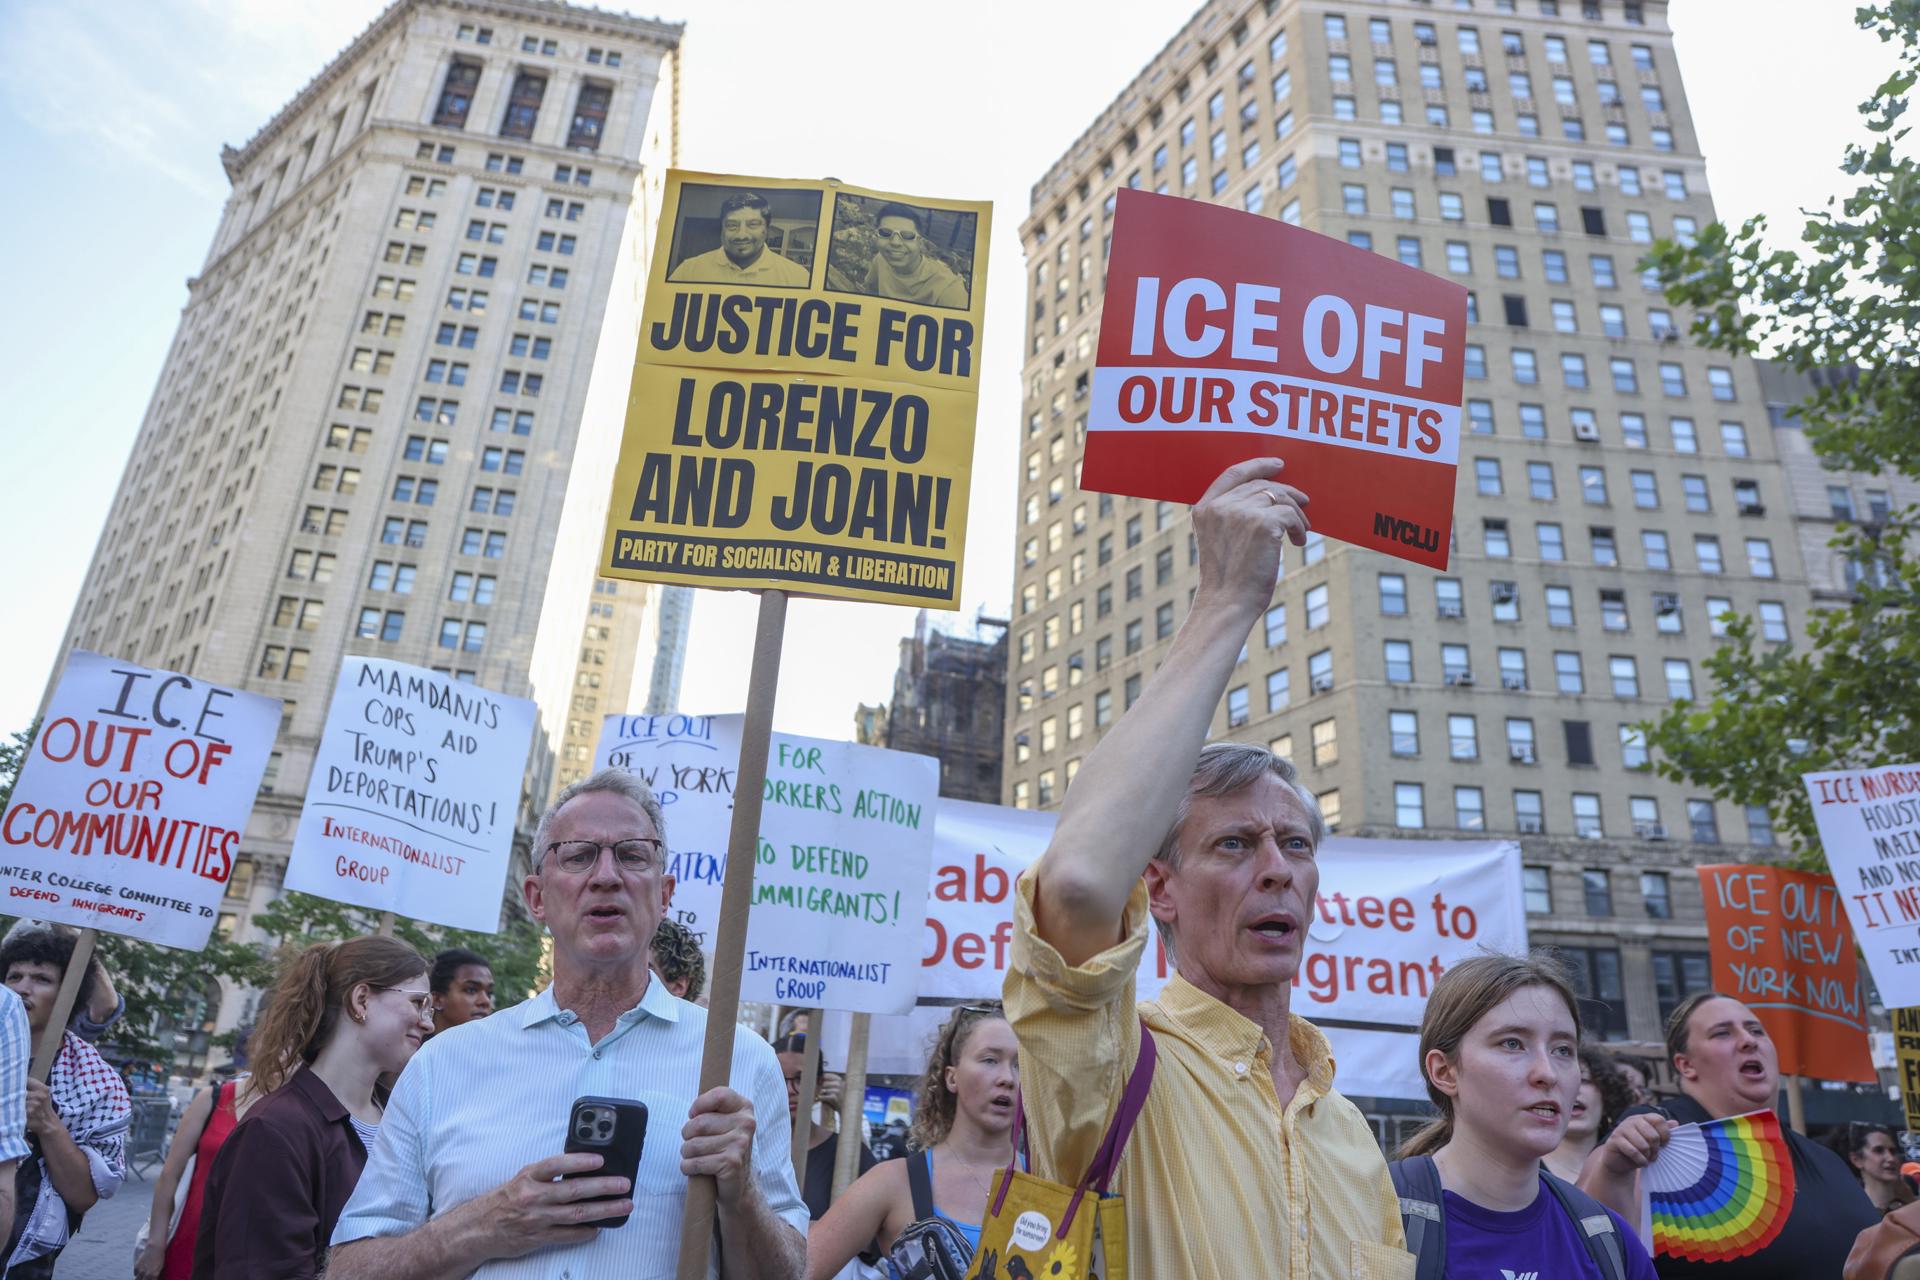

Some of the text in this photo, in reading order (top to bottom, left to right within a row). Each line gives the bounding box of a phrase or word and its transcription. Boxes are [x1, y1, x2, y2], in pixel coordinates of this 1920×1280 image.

[650, 292, 974, 378] JUSTICE FOR
[1130, 276, 1445, 389] ICE OFF
[671, 377, 930, 465] LORENZO
[1117, 375, 1443, 455] OUR STREETS
[630, 452, 952, 550] AND JOAN!
[1373, 512, 1440, 553] NYCLU
[618, 537, 950, 591] PARTY FOR SOCIALISM & LIBERATION
[358, 664, 501, 729] MAMDANI'S
[365, 698, 478, 755] COPS AID
[667, 715, 716, 740] OUT
[41, 717, 232, 785] OUT OF
[344, 729, 438, 783] TRUMP'S
[608, 751, 636, 768] OF
[778, 743, 826, 775] FOR
[85, 778, 163, 811] OUR
[327, 766, 496, 835] DEPORTATIONS!
[762, 778, 922, 830] ORKERS ACTION
[1813, 777, 1859, 805] ICE
[2, 803, 239, 883] COMMUNITIES
[321, 816, 466, 877] INTERNATIONALIST
[755, 836, 869, 880] TO DEFEND
[335, 855, 389, 885] GROUP
[1858, 865, 1894, 890] AND
[10, 886, 60, 903] DEFEND
[47, 872, 113, 895] COLLEGE
[119, 887, 192, 913] COMMITTEE
[198, 905, 213, 918] TO
[677, 910, 697, 925] TO
[1431, 892, 1477, 940] to
[1713, 871, 1840, 928] ICE OUT
[1852, 892, 1892, 928] IT
[747, 951, 892, 985] INTERNATIONALIST
[1727, 925, 1843, 966] OF NEW
[776, 977, 826, 1000] GROUP
[1728, 962, 1861, 1018] YORK NOW
